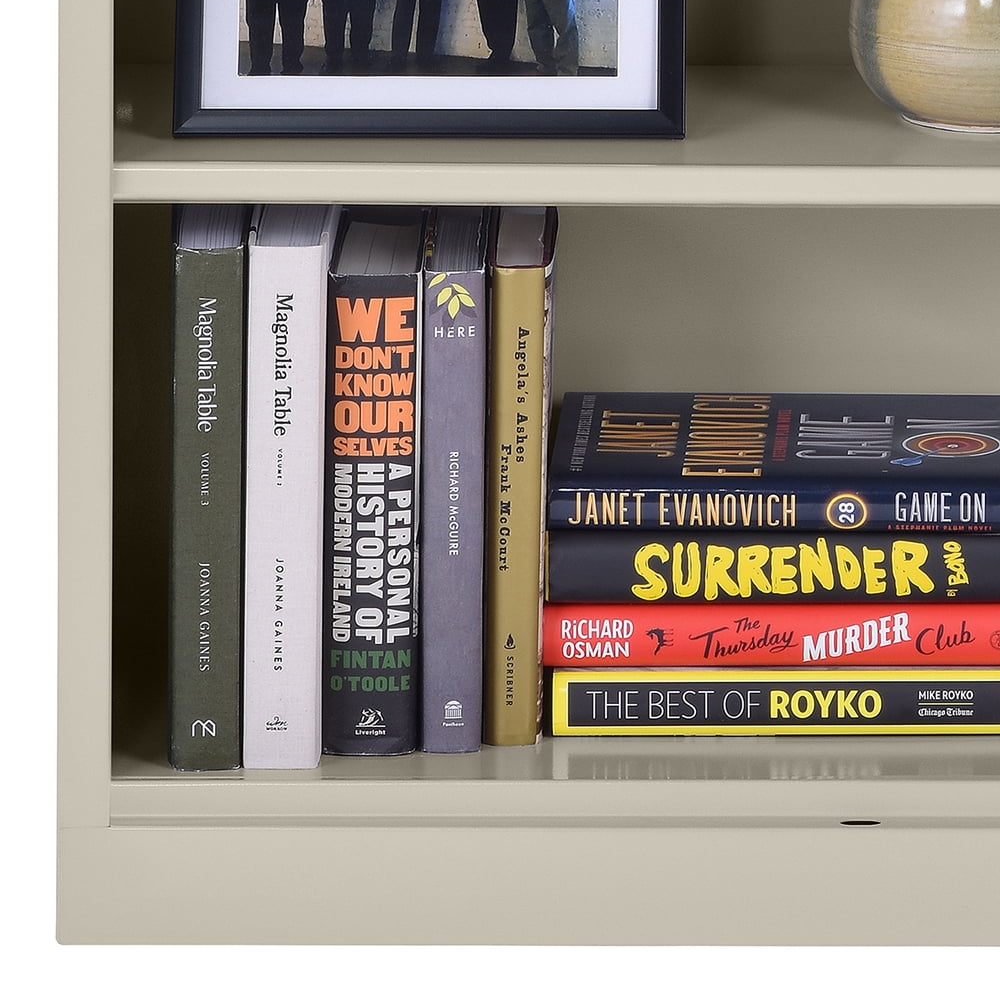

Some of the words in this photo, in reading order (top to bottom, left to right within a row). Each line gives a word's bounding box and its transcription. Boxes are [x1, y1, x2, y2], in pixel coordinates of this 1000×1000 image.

[193, 297, 218, 381] Magnolia
[271, 293, 294, 381] Magnolia
[335, 296, 415, 343] WE
[434, 325, 476, 338] HERE
[335, 345, 415, 370] DON'T
[515, 327, 530, 404] Angela's
[334, 372, 414, 397] KNOW
[196, 384, 218, 433] Table
[273, 385, 292, 437] Table
[333, 400, 414, 434] OUR
[333, 436, 413, 457] SELVES
[515, 412, 529, 463] Ashes
[596, 410, 681, 458] JANET
[681, 394, 772, 477] EVANOVICH
[795, 413, 894, 459] GAME
[200, 452, 210, 496] VOLUME
[388, 463, 412, 480] A
[449, 451, 460, 501] RICHARD
[500, 444, 512, 493] Frank
[333, 463, 353, 552] MODERN
[448, 505, 460, 556] McGUIRE
[568, 492, 646, 526] JANET
[659, 493, 797, 527] EVANOVICH
[838, 501, 855, 524] 28
[894, 492, 952, 523] GAME
[959, 492, 986, 523] ON
[355, 463, 385, 600] HISTORY
[498, 500, 511, 572] McCourt
[275, 558, 284, 612] JOANNA
[386, 489, 412, 645] PERSONAL
[630, 537, 935, 601] SURRENDER
[943, 541, 970, 586] BONO
[198, 562, 211, 616] JOANNA
[332, 555, 352, 643] IRELAND
[199, 621, 211, 672] GAINES
[273, 620, 283, 672] GAINES
[355, 607, 384, 645] OF
[688, 624, 799, 659] Thursday
[733, 617, 760, 634] The
[802, 611, 912, 663] MURDER
[915, 620, 976, 656] Club
[330, 649, 412, 669] FINTAN
[562, 641, 630, 659] OSMAN
[330, 675, 411, 692] O'TOOLE
[505, 656, 514, 706] SCRIBNER
[586, 690, 640, 719] THE
[648, 690, 715, 719] BEST
[722, 690, 761, 719] OF
[769, 689, 882, 719] ROYKO
[918, 690, 941, 700] MIKE
[942, 690, 974, 700] ROYKO
[918, 708, 946, 717] Chicago
[946, 708, 974, 716] Tribune
